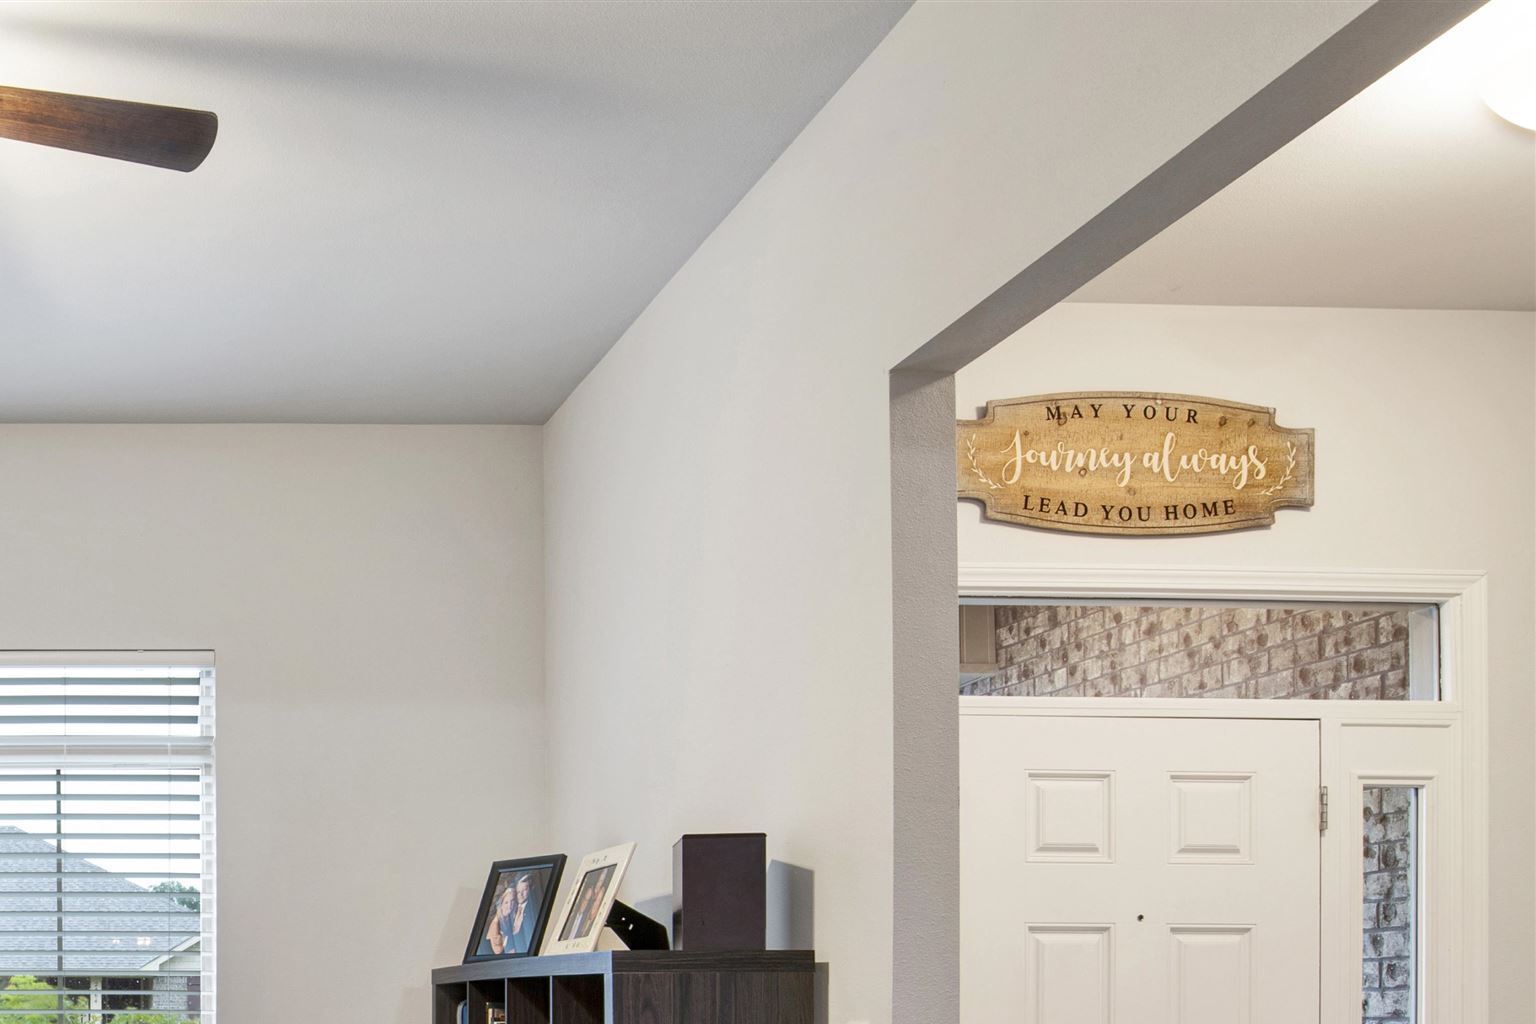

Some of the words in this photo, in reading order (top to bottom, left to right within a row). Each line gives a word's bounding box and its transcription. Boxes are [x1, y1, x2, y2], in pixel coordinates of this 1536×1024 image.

[1045, 403, 1104, 422] MAY
[1122, 403, 1200, 425] YOUR
[1000, 429, 1138, 488] Journey
[1143, 431, 1269, 490] always
[1022, 494, 1089, 518] LEAD
[1101, 504, 1152, 523] YOU
[1164, 498, 1237, 521] HOME
